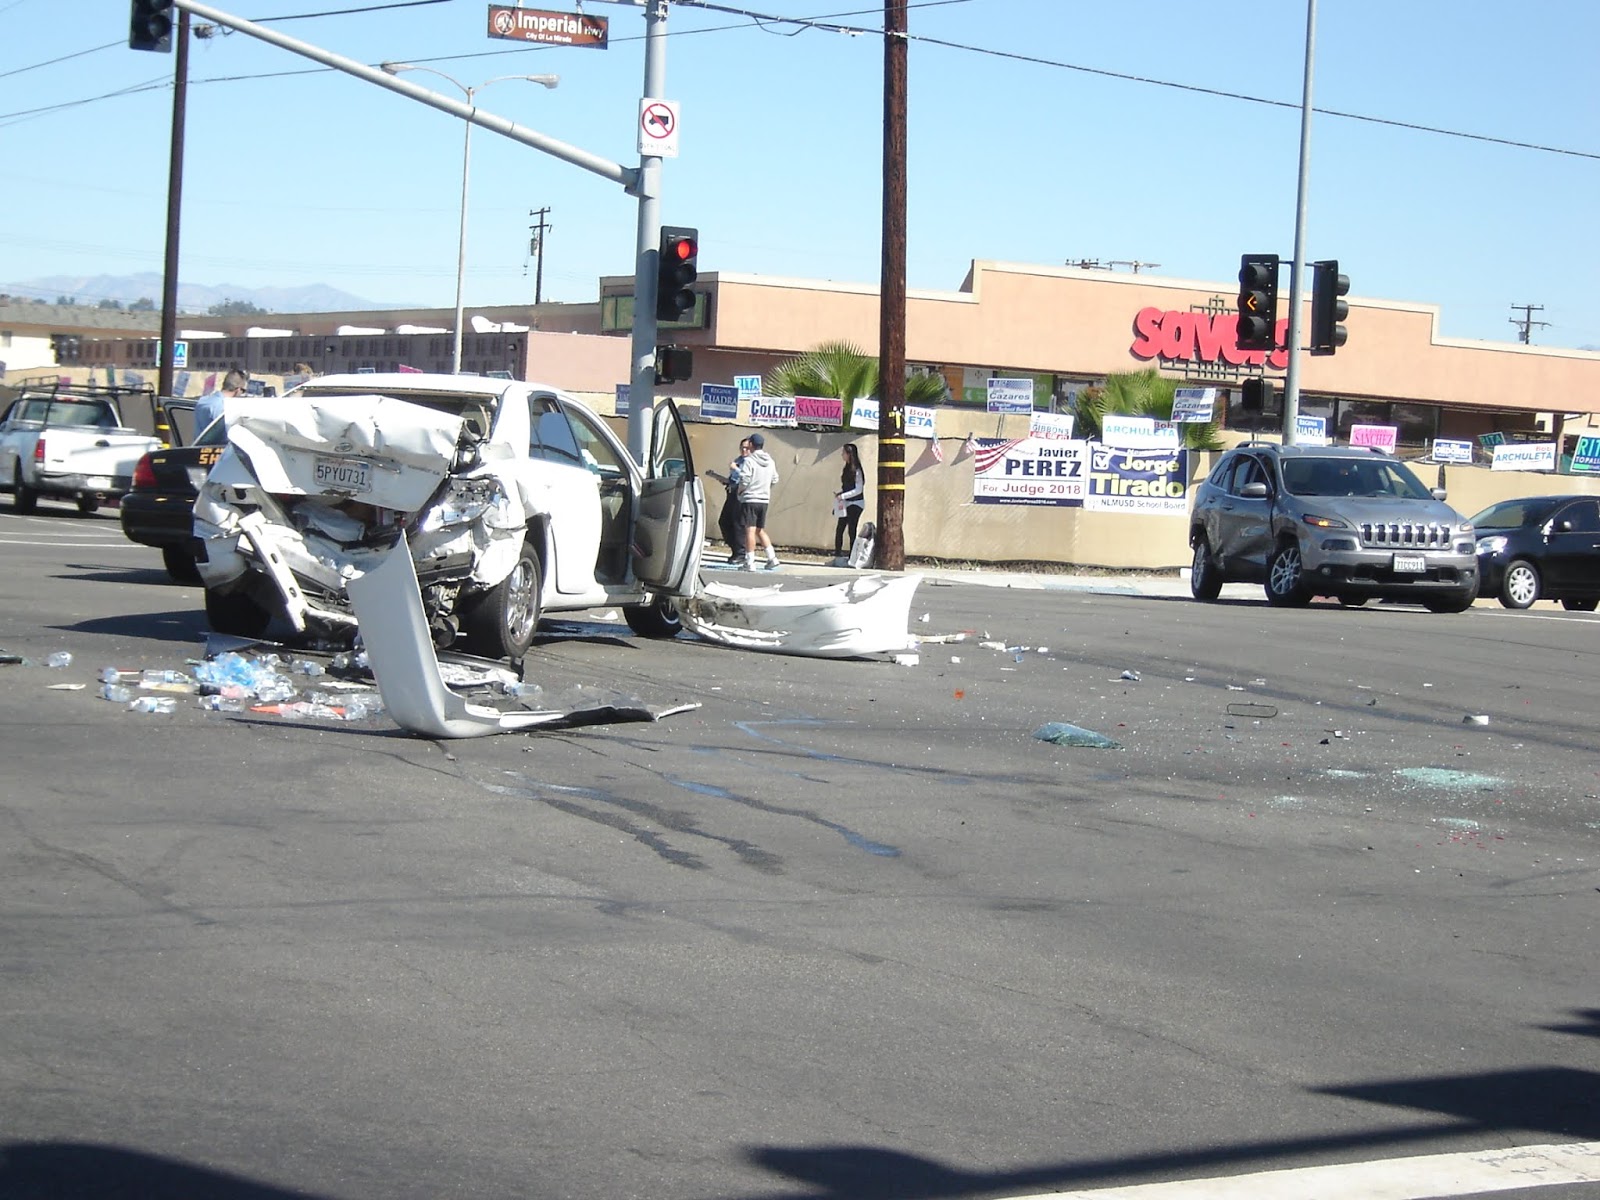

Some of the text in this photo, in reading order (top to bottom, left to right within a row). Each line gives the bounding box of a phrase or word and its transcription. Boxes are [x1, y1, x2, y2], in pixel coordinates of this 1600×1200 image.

[517, 11, 604, 38] Imperial Hwy
[526, 32, 537, 40] City
[553, 35, 572, 43] Mirada
[736, 378, 760, 390] RITA
[702, 393, 737, 405] CUADRA
[989, 392, 1030, 401] Cazares
[751, 399, 795, 417] COLETTA
[798, 403, 841, 418] SANCHEZ
[909, 408, 932, 418] Bob
[1105, 425, 1175, 437] ARCHULETA
[1154, 421, 1174, 429] Bob
[1355, 433, 1393, 446] SANCHEZ
[1479, 434, 1502, 445] RITA
[1038, 447, 1079, 458] Javier
[1495, 451, 1553, 462] ARCHULETA
[1005, 458, 1082, 477] PEREZ
[1119, 453, 1180, 475] Jorge
[317, 464, 366, 486] 5PYU731
[982, 483, 1081, 496] For Judge 2018
[1089, 472, 1184, 498] Tirado
[1101, 499, 1135, 508] NLMUSD
[1136, 500, 1162, 508] School
[1164, 501, 1186, 509] Board
